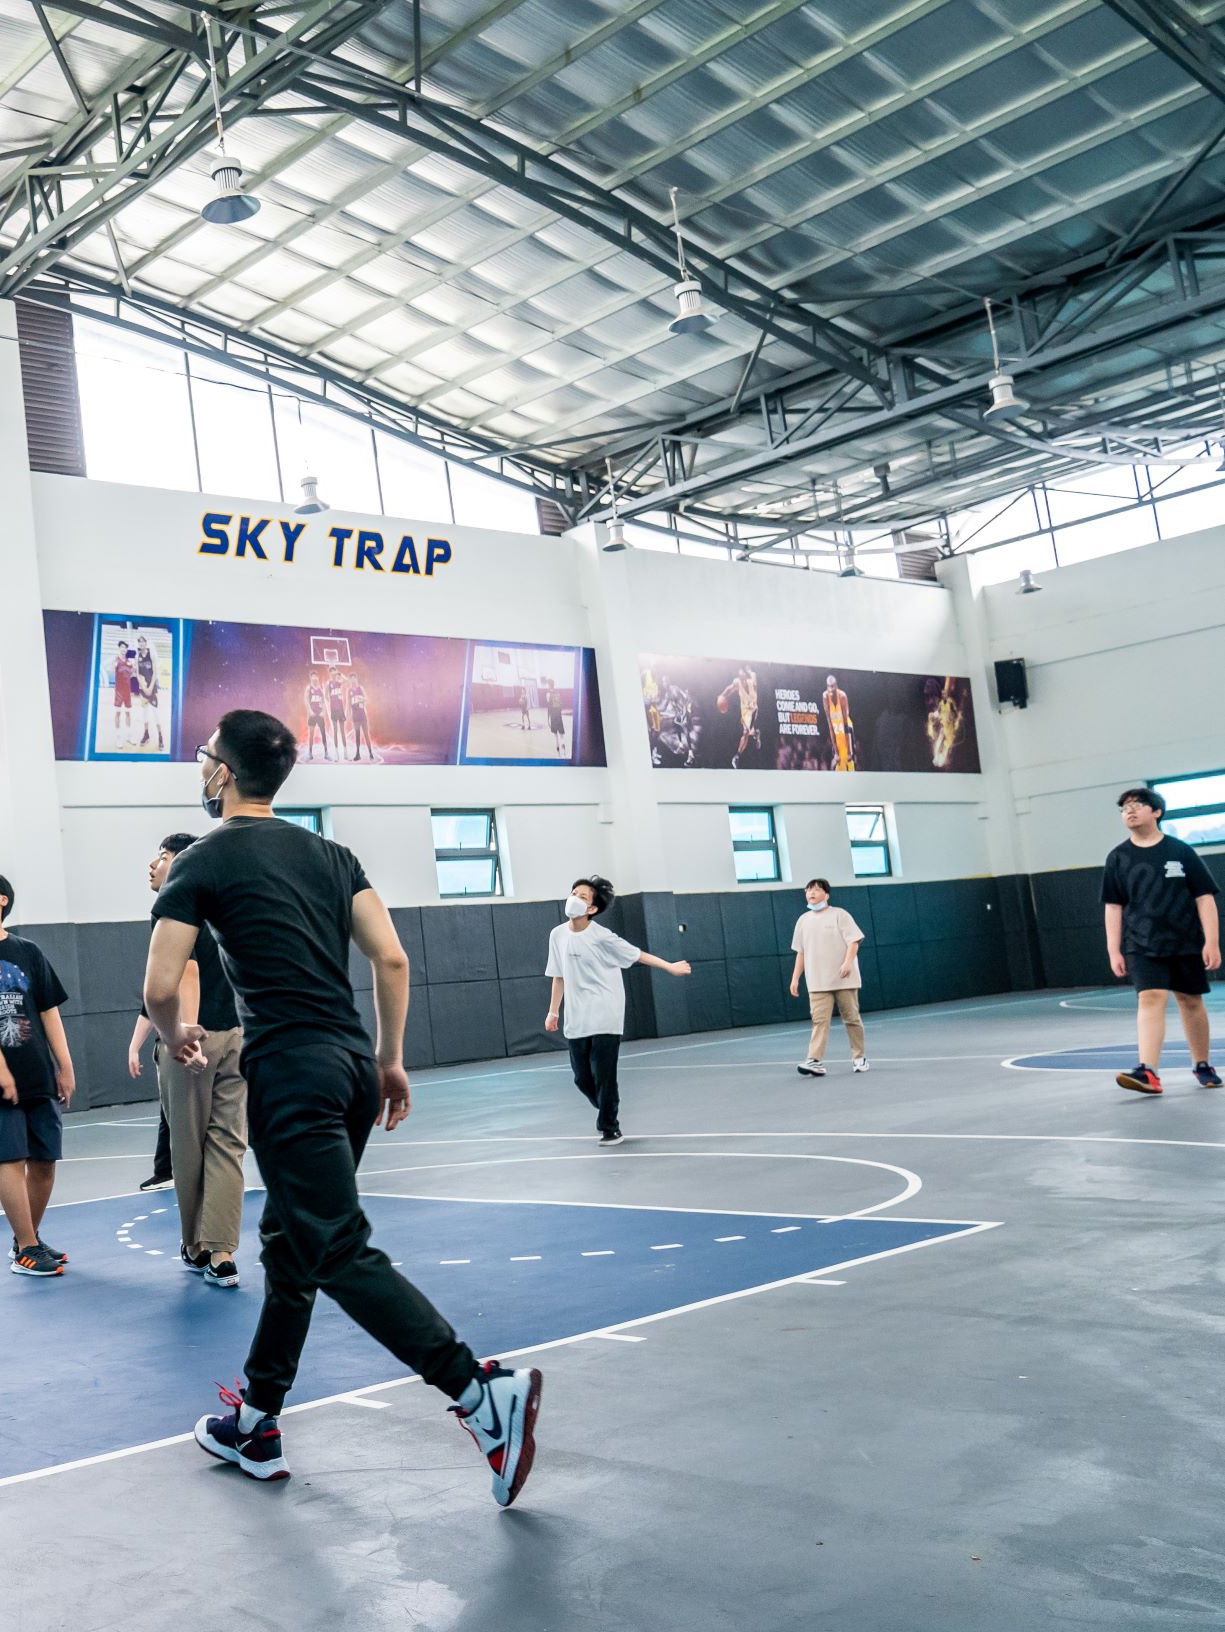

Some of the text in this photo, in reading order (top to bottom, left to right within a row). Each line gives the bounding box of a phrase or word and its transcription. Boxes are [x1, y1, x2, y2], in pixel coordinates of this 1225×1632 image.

[197, 511, 453, 577] SKY TRAP
[775, 689, 800, 701] HEROES
[776, 700, 795, 712] COME
[795, 701, 808, 713] AND
[777, 712, 790, 723] BUT
[790, 713, 818, 724] LEGENDS
[779, 723, 792, 735] ARE
